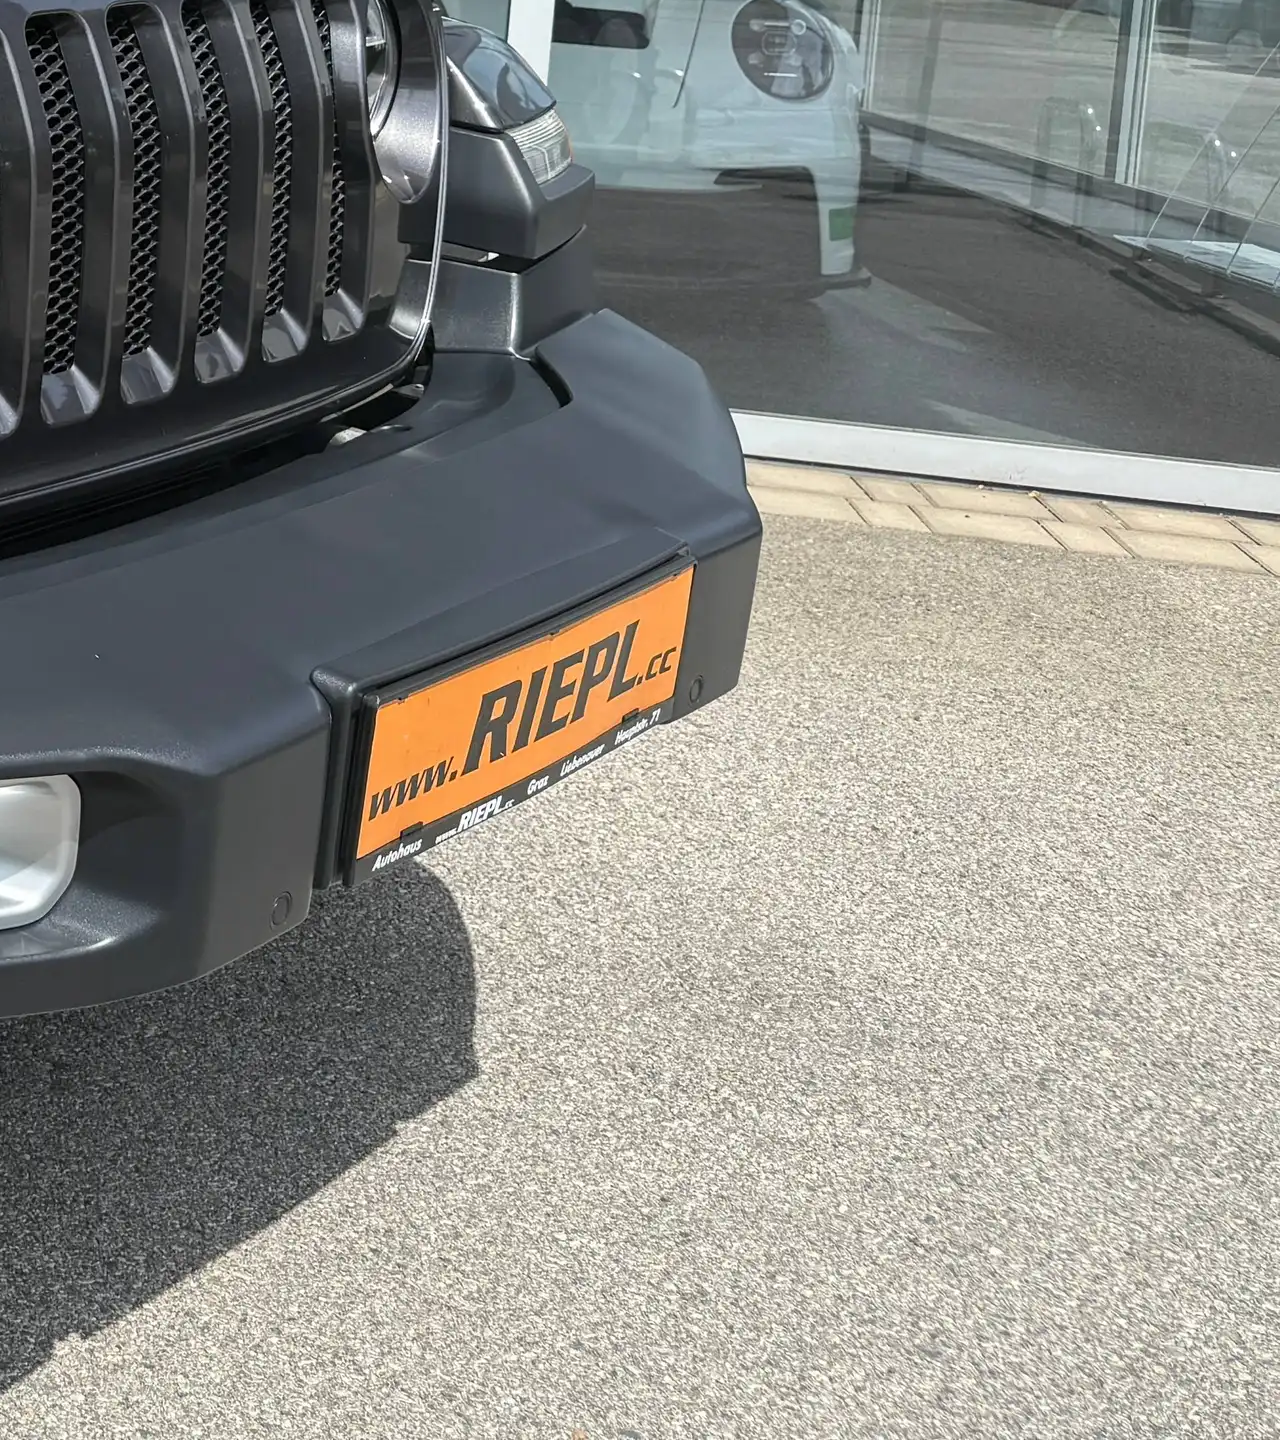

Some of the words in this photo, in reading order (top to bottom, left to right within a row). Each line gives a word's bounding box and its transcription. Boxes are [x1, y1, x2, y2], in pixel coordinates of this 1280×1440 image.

[368, 619, 677, 821] www.RIEPL.cc
[372, 838, 423, 872] Autohaus
[527, 775, 550, 795] Graz
